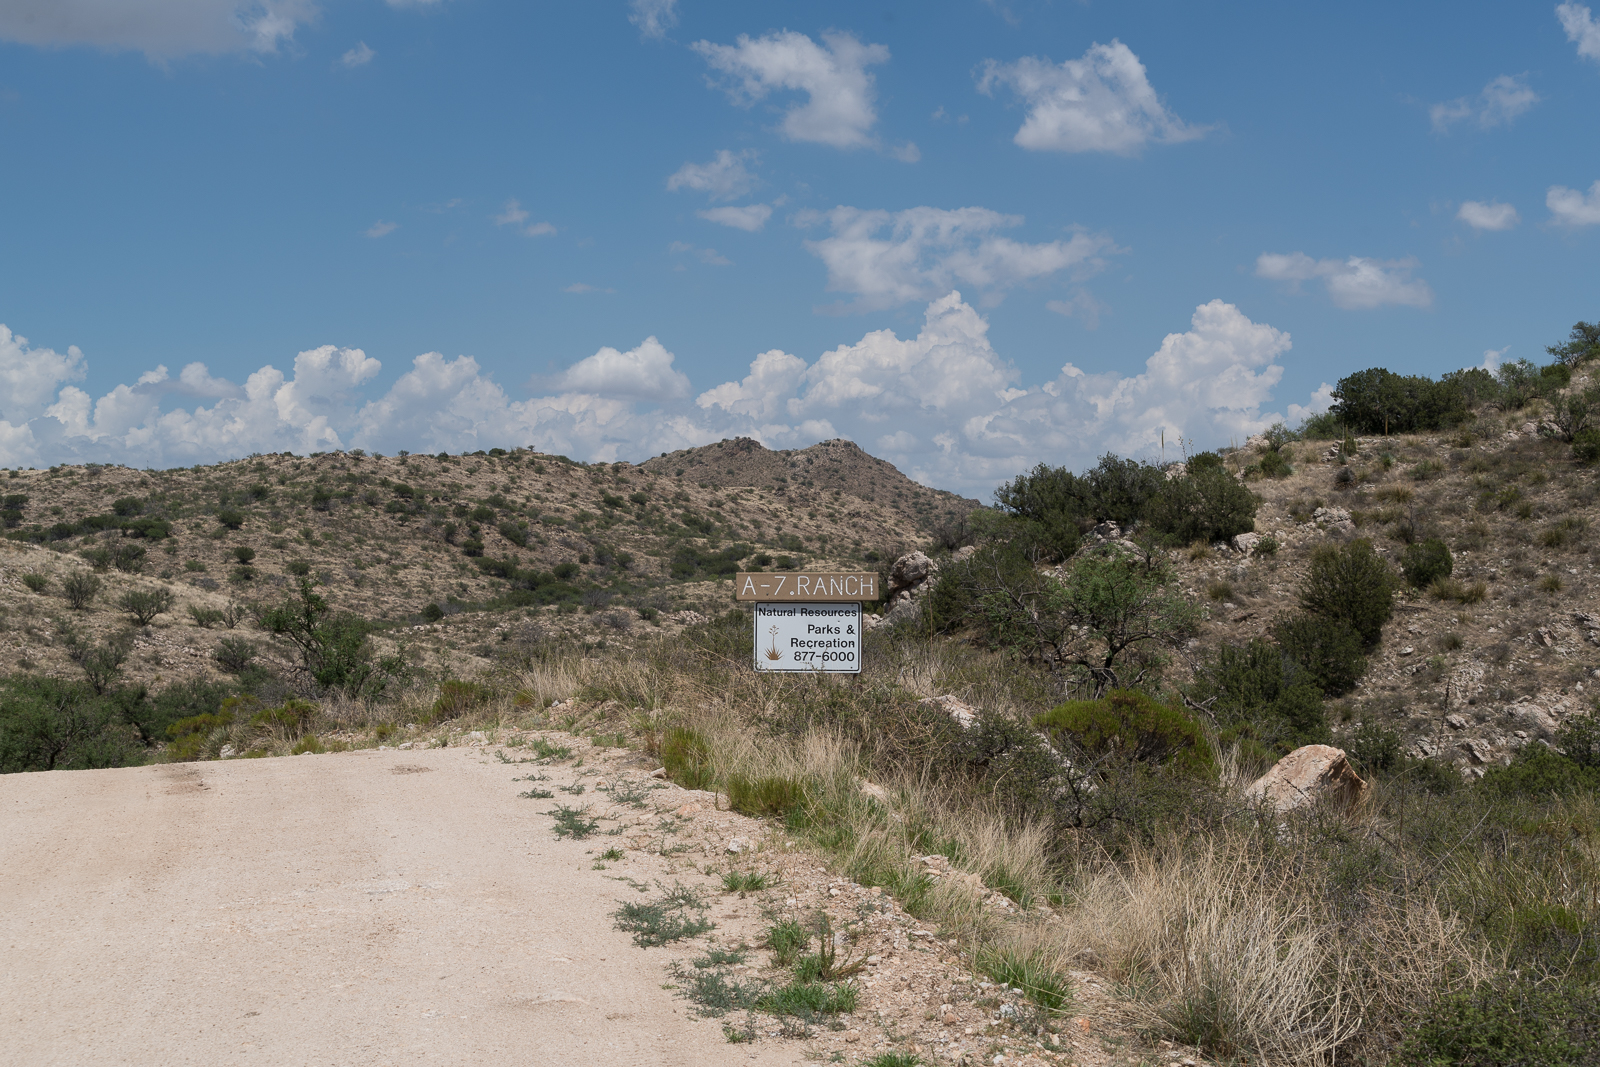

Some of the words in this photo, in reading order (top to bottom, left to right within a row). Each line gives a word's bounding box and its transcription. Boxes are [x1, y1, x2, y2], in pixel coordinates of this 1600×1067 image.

[758, 608, 796, 617] Natural
[800, 608, 857, 617] Resources
[808, 624, 840, 634] Parks
[846, 625, 856, 635] &
[791, 638, 855, 648] Recreation
[794, 652, 855, 661] 877-6000
